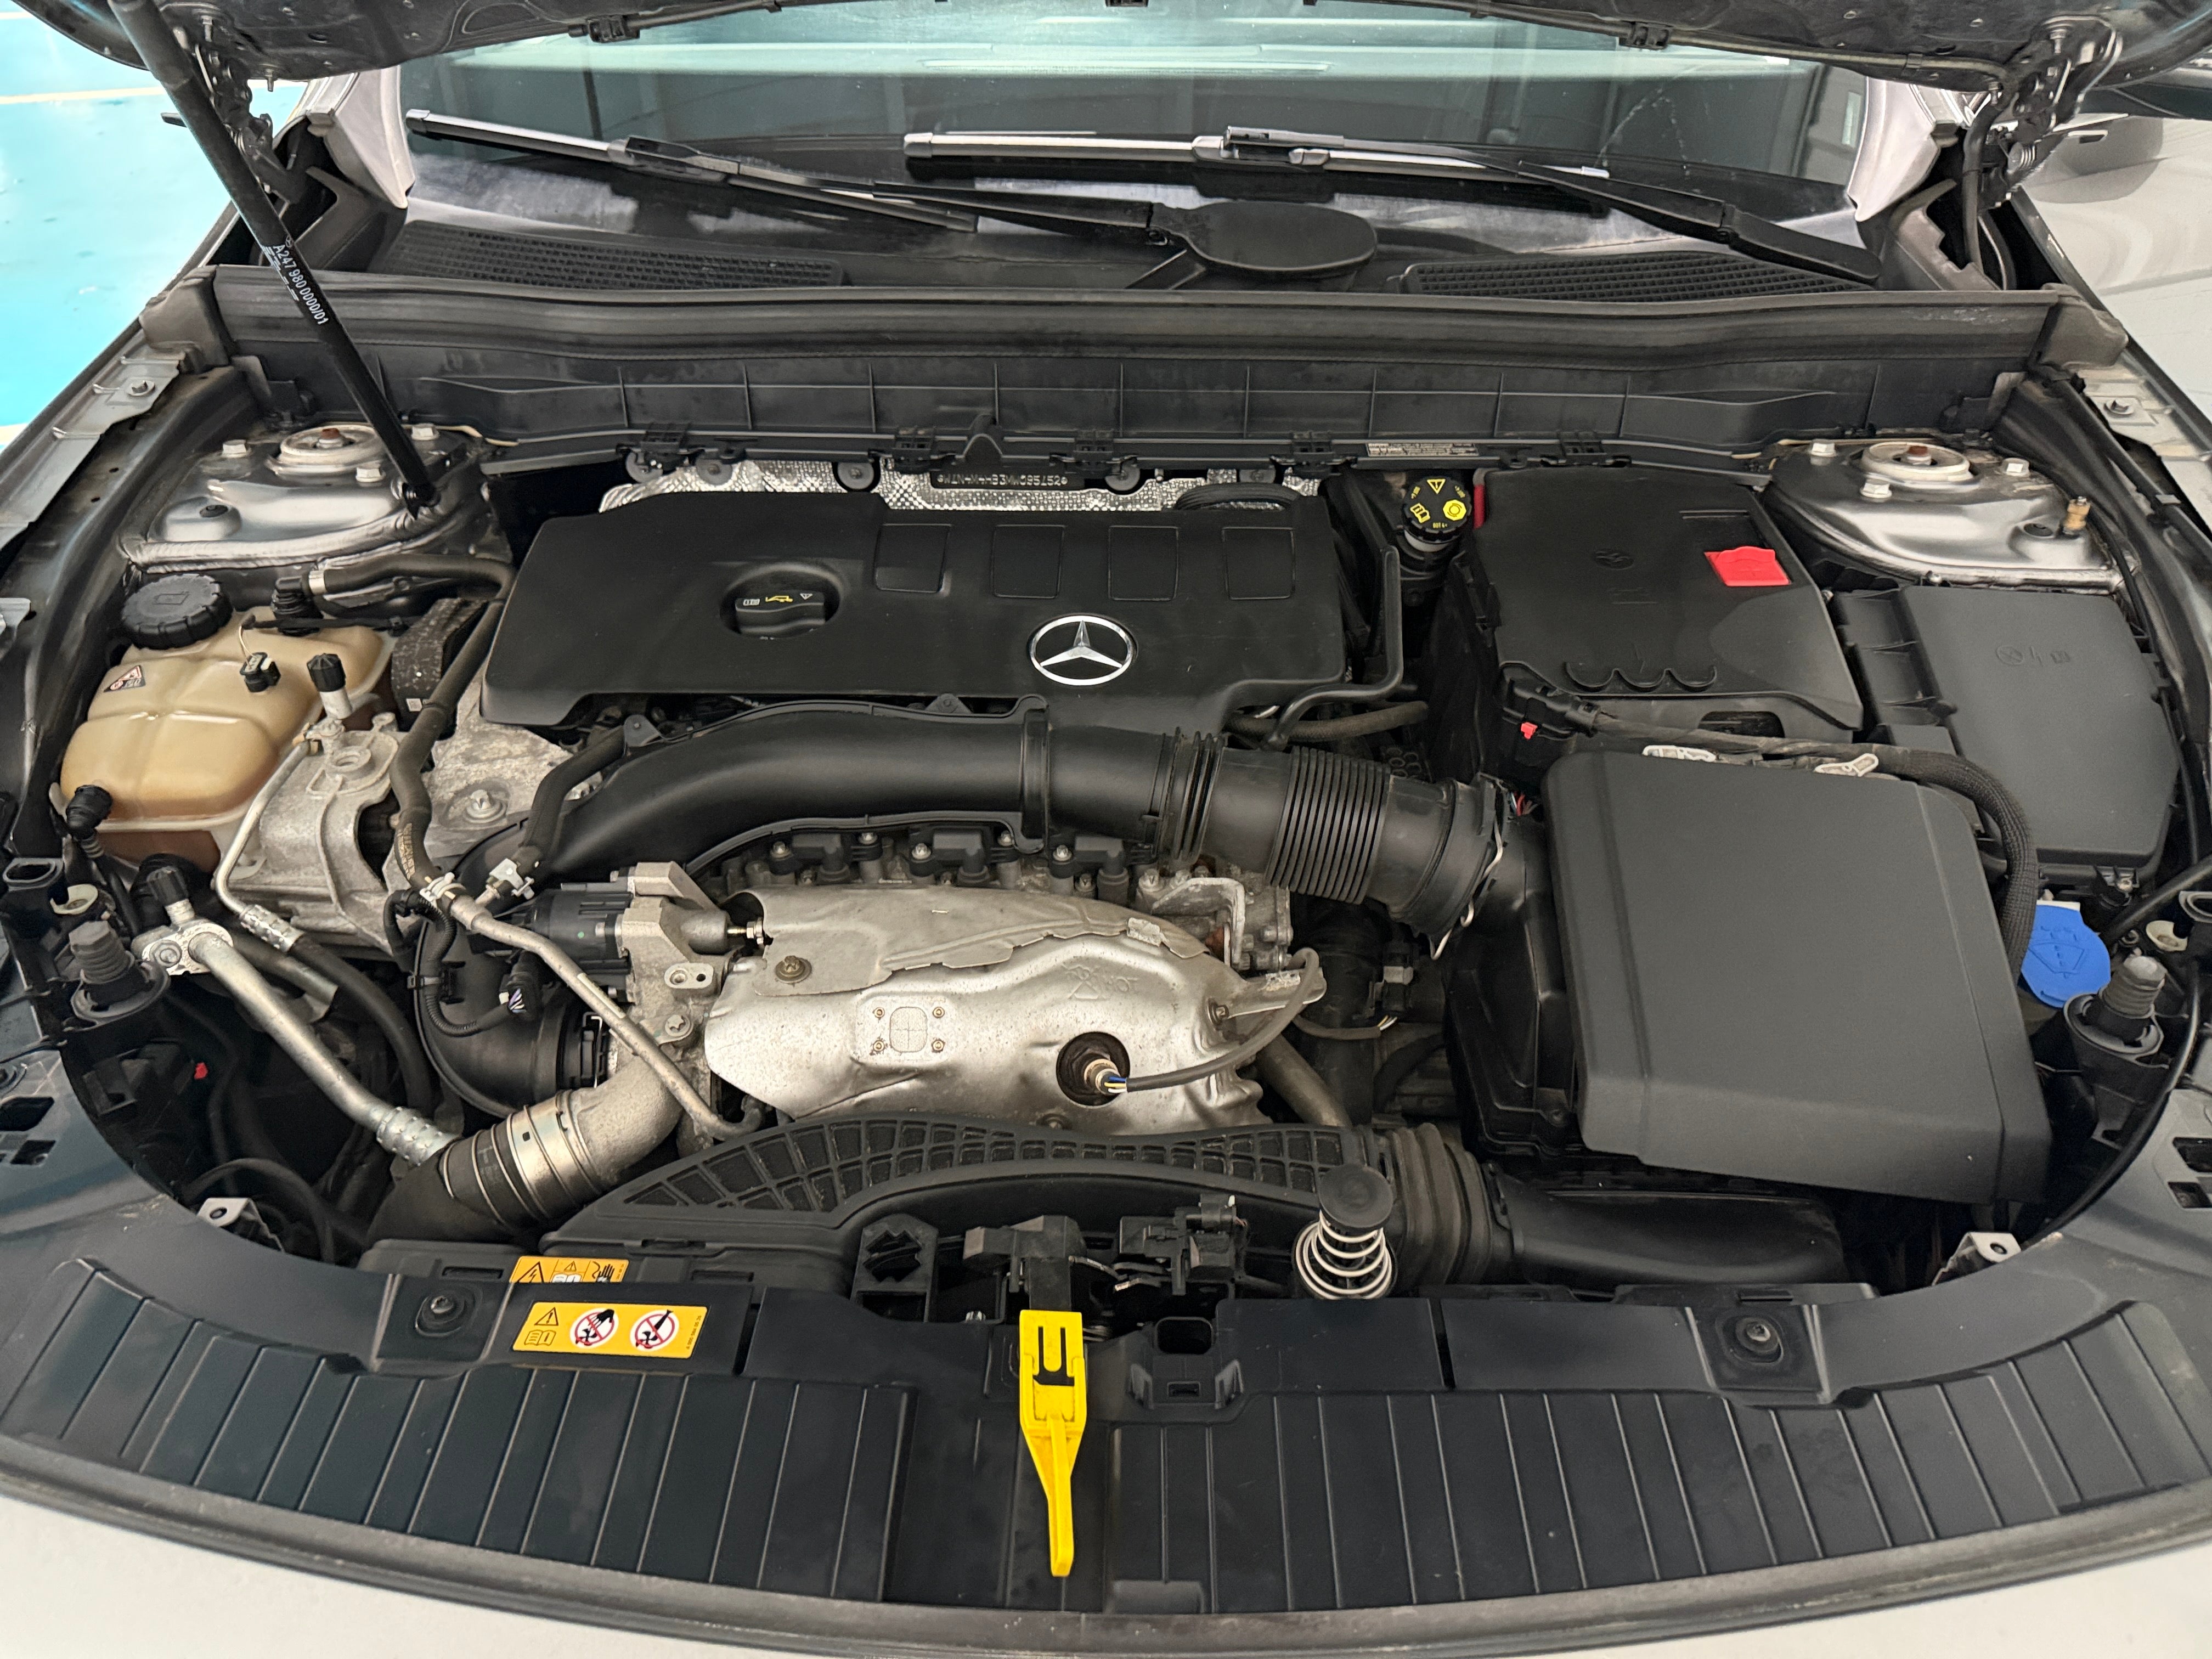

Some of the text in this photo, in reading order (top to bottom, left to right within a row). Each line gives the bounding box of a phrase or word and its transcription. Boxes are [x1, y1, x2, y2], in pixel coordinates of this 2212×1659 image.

[274, 245, 329, 324] A247 980 0000/01
